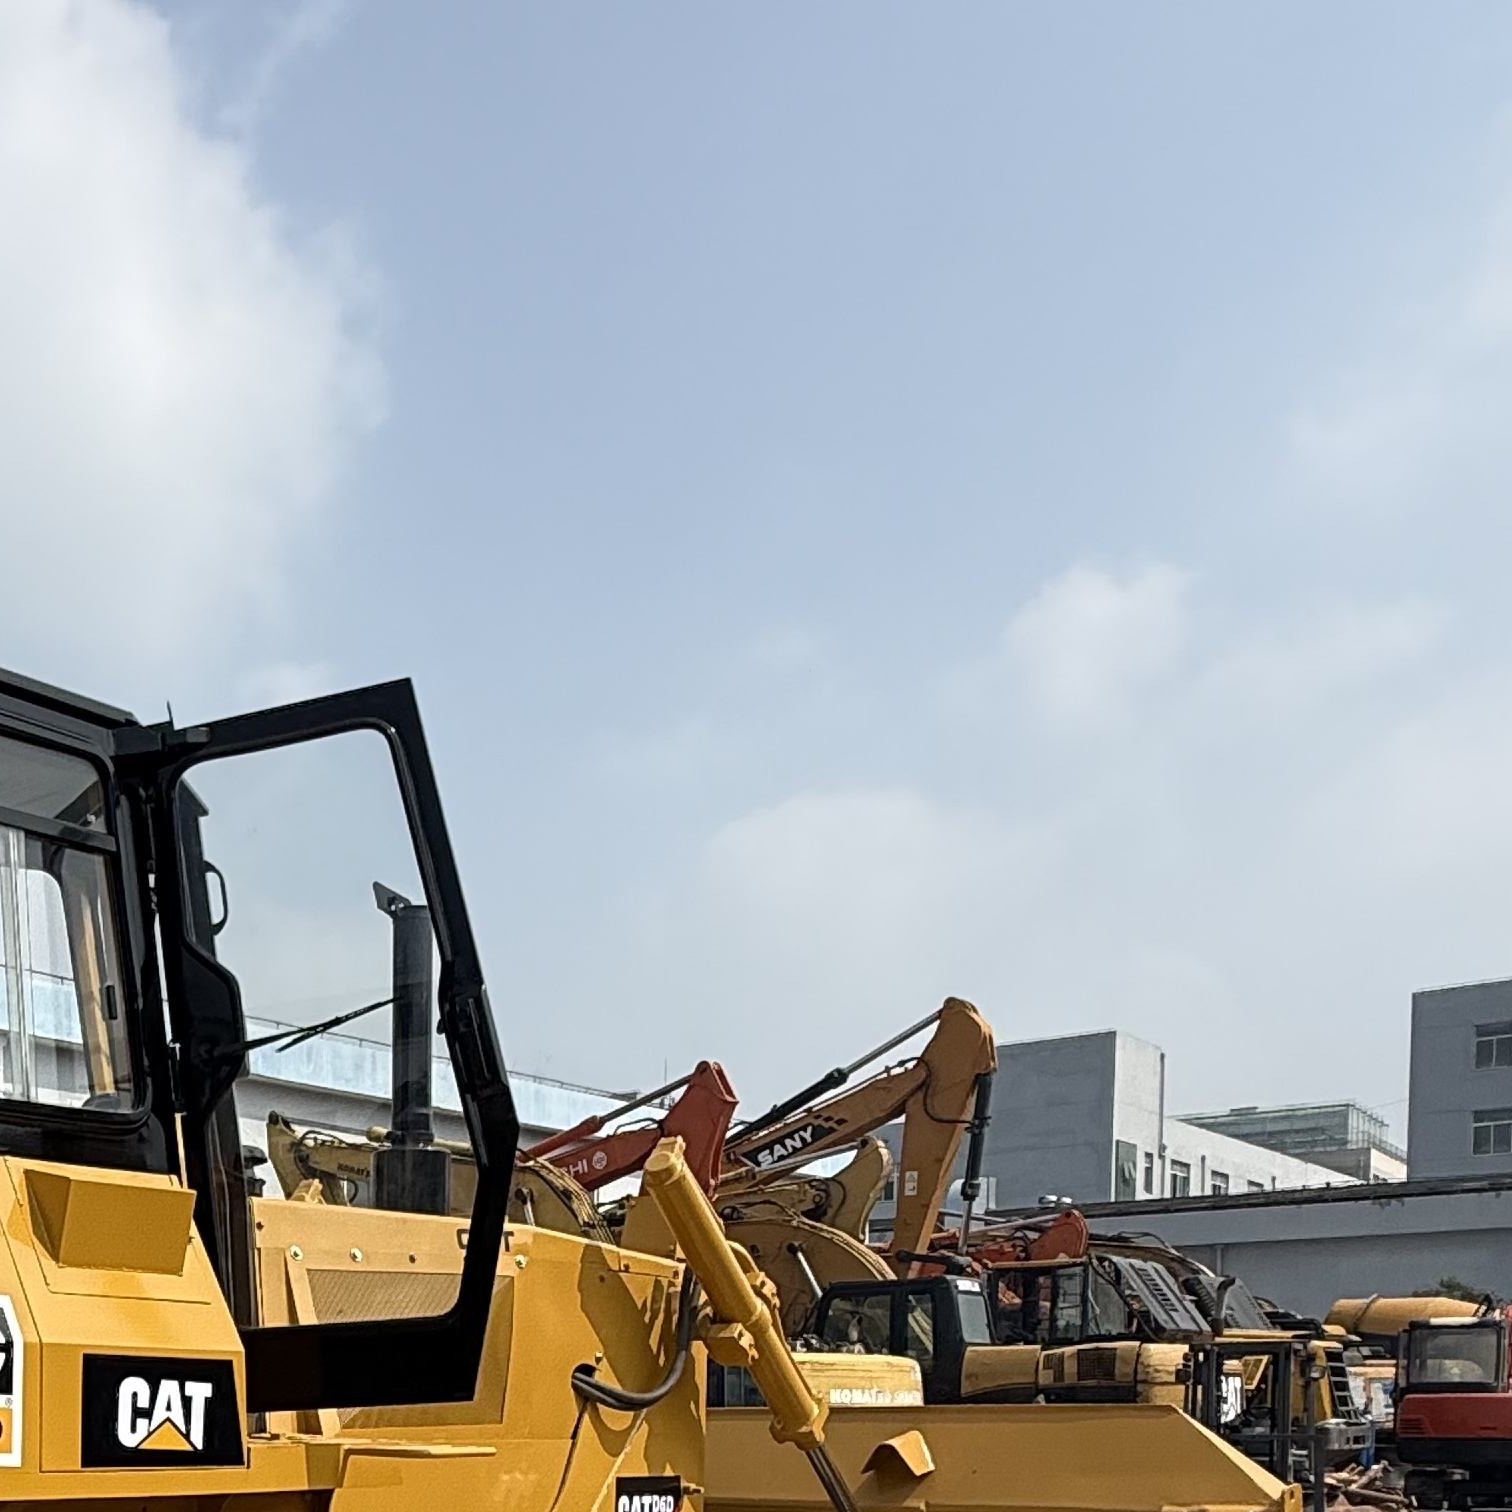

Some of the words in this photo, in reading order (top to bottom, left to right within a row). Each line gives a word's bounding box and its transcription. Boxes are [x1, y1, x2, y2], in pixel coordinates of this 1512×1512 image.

[757, 1125, 813, 1168] SANY
[562, 1158, 588, 1177] HI
[456, 1228, 514, 1252] CT
[117, 1376, 213, 1450] CAT
